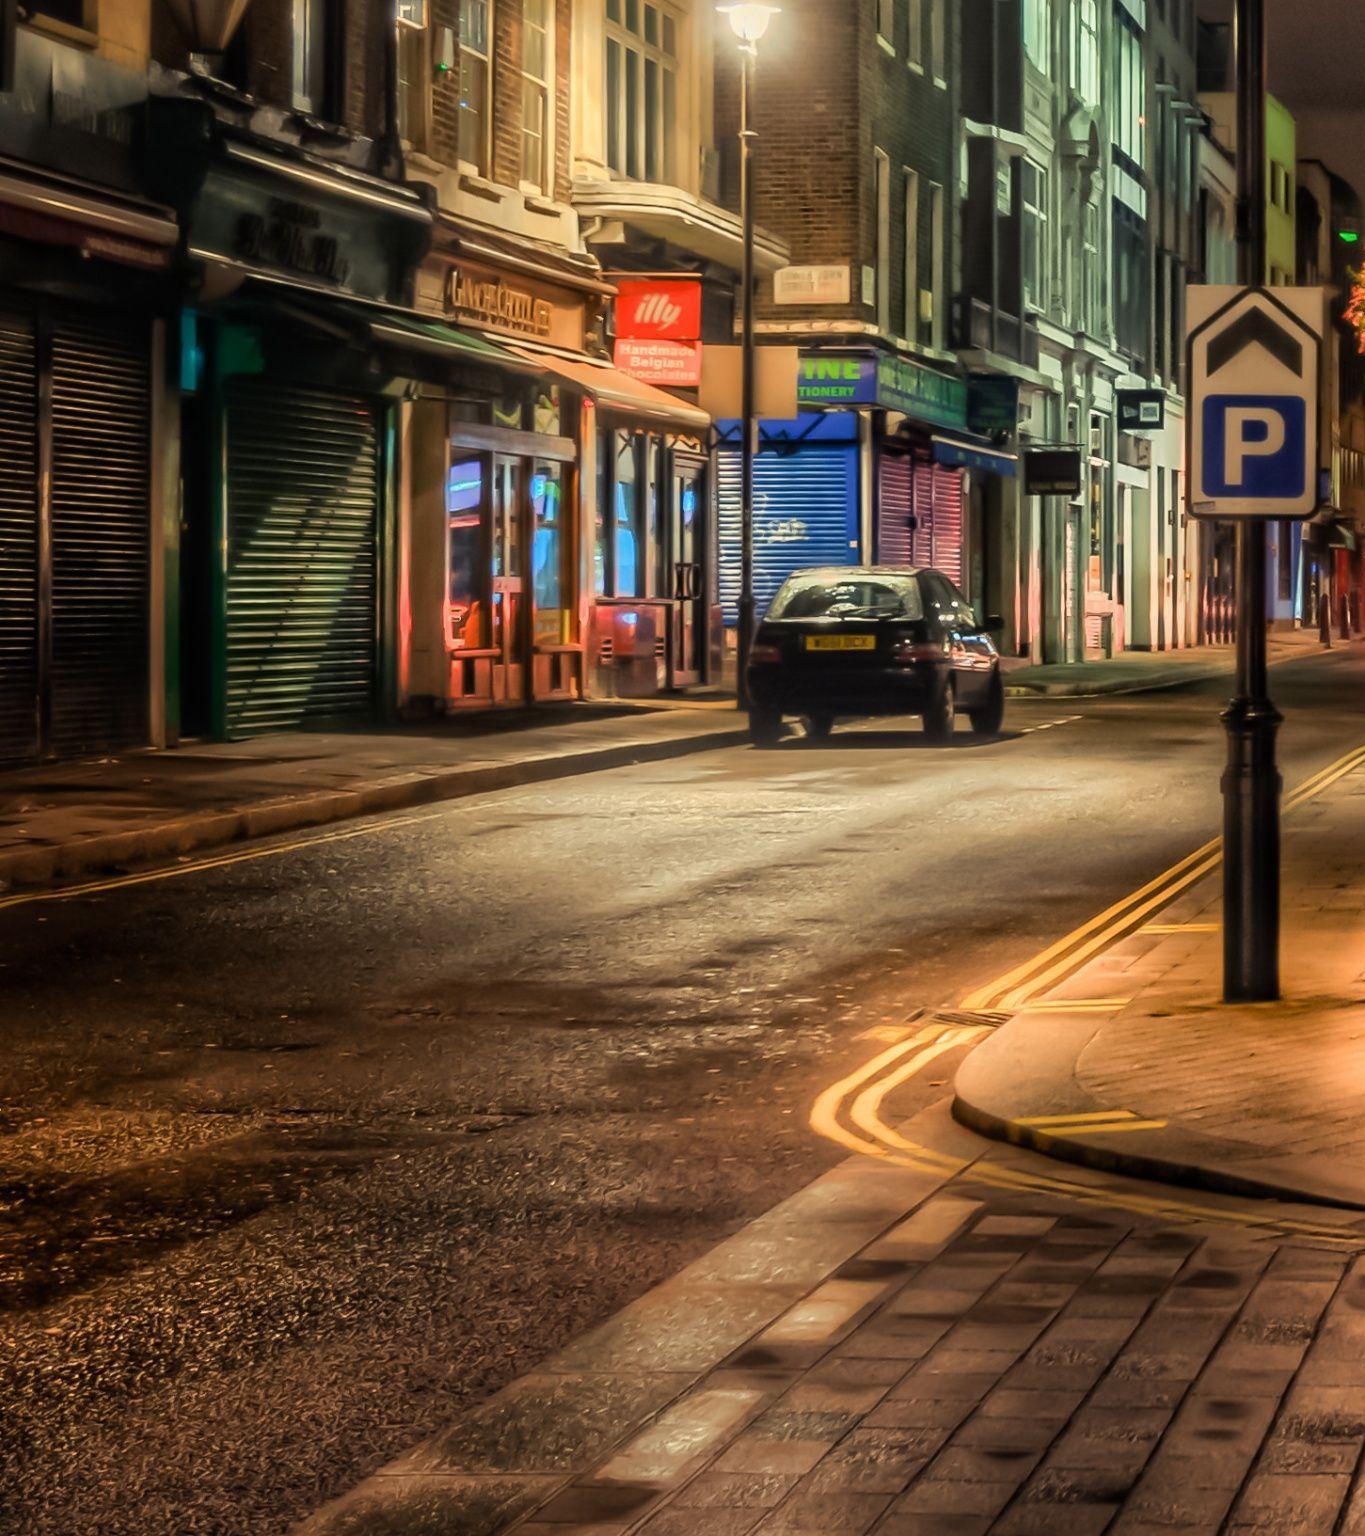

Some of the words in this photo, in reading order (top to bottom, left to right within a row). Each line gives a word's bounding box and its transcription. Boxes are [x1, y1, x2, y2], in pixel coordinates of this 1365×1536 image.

[635, 293, 682, 331] illy
[620, 345, 696, 356] Handmade
[630, 356, 685, 370] Belgian
[1224, 407, 1286, 486] P
